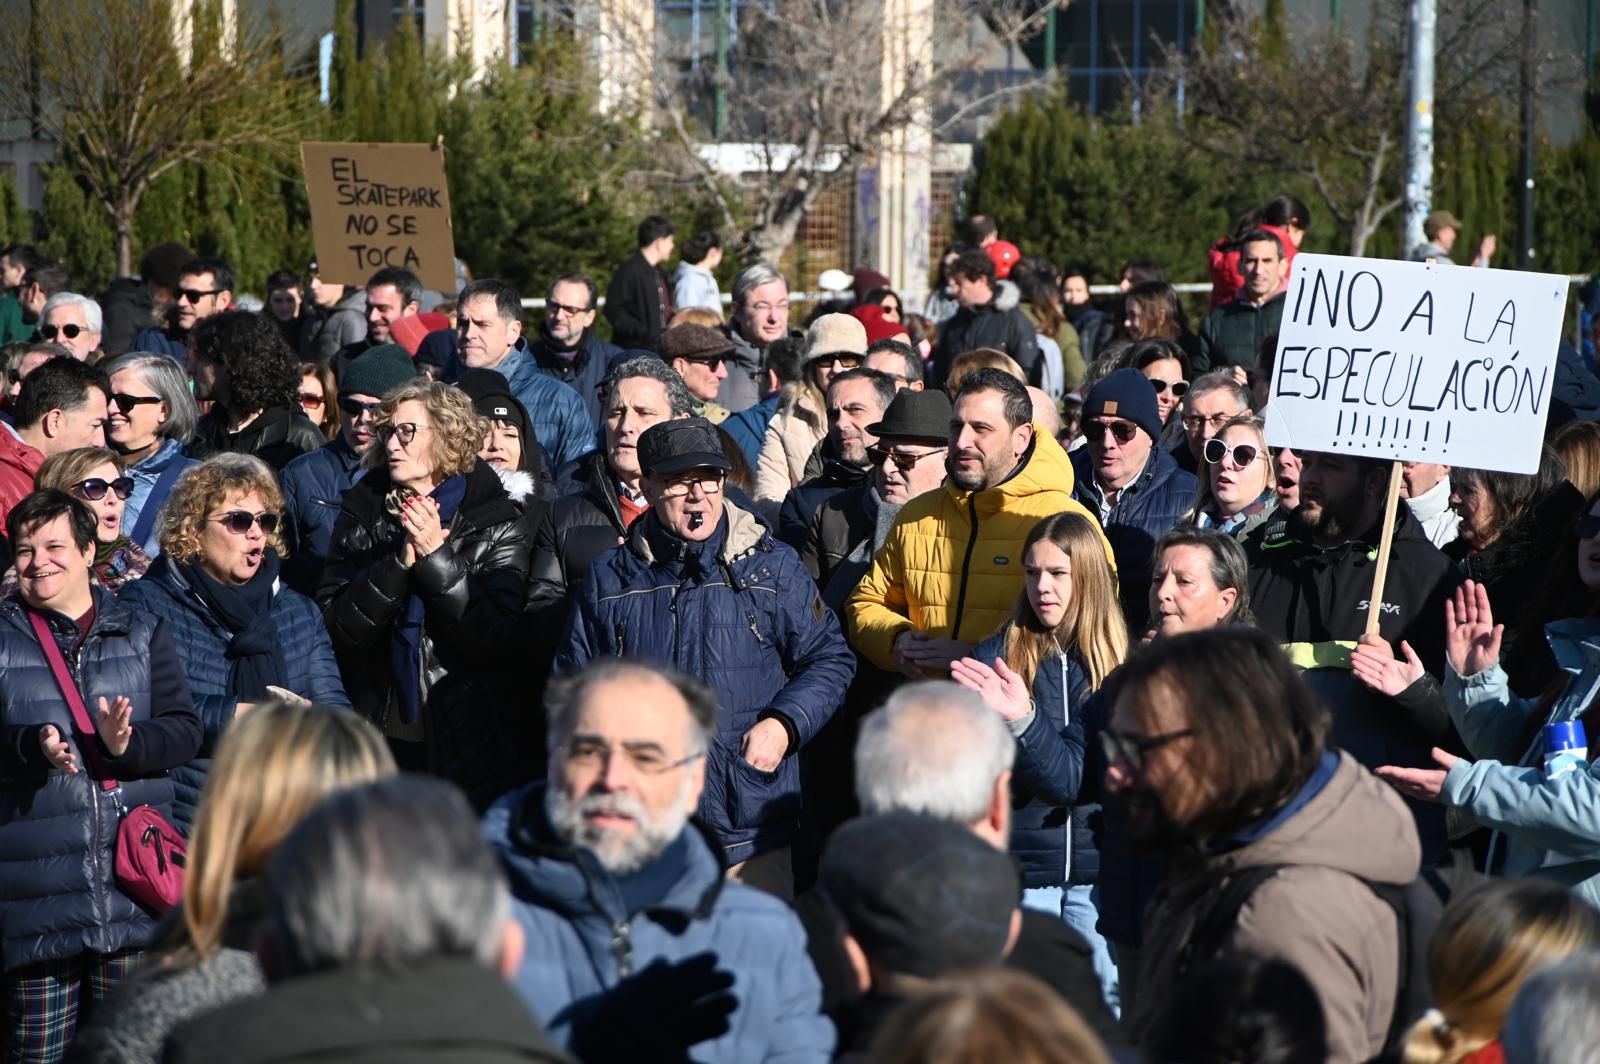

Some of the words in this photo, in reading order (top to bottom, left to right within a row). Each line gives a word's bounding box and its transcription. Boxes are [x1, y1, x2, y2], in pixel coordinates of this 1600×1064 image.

[331, 157, 369, 183] EL
[337, 183, 442, 208] SKATEPARK
[345, 213, 378, 235] NO
[386, 214, 418, 236] SE
[348, 245, 420, 270] TOCA
[1400, 290, 1434, 336] A
[1464, 291, 1516, 345] LA
